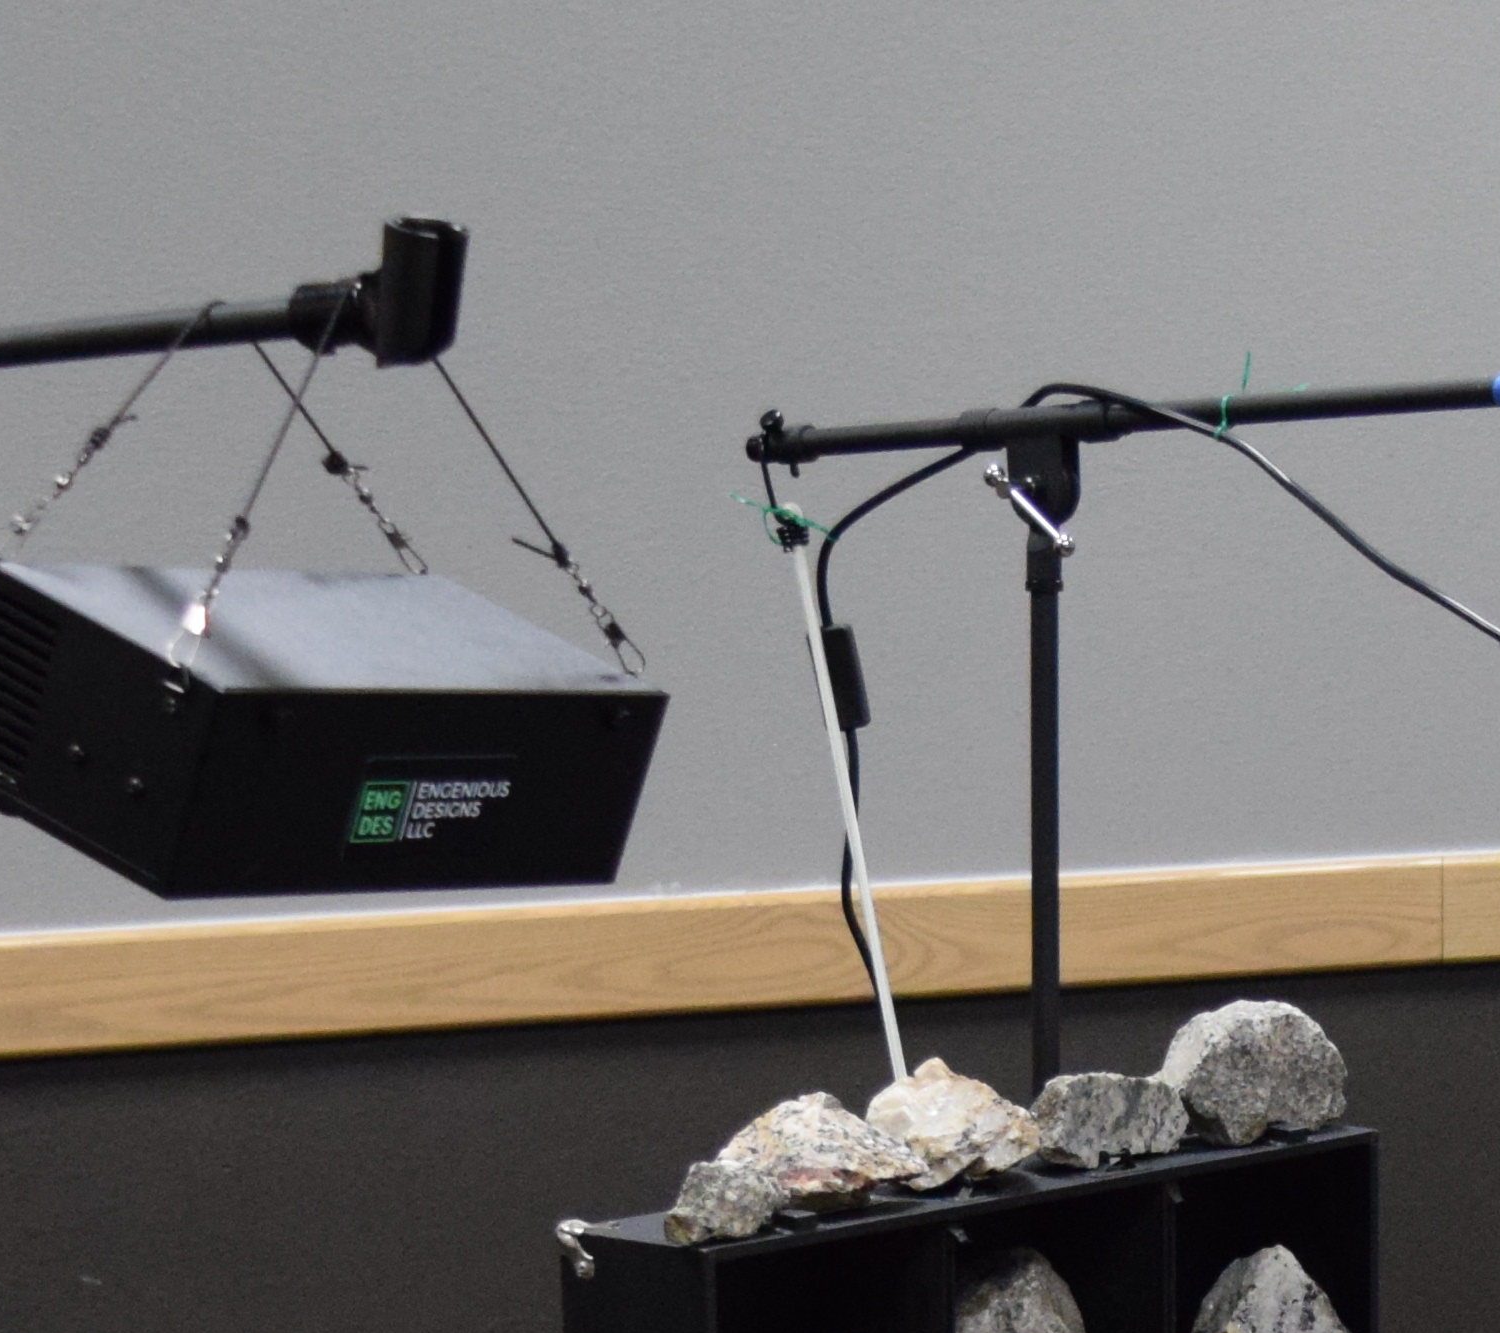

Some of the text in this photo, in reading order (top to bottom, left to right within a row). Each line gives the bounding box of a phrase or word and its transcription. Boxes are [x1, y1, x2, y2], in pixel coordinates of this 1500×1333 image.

[417, 780, 511, 799] ENGENIOUS
[363, 790, 401, 811] ENG
[411, 801, 482, 820] DESIGNS
[358, 815, 394, 836] DES
[406, 821, 436, 839] LLC
